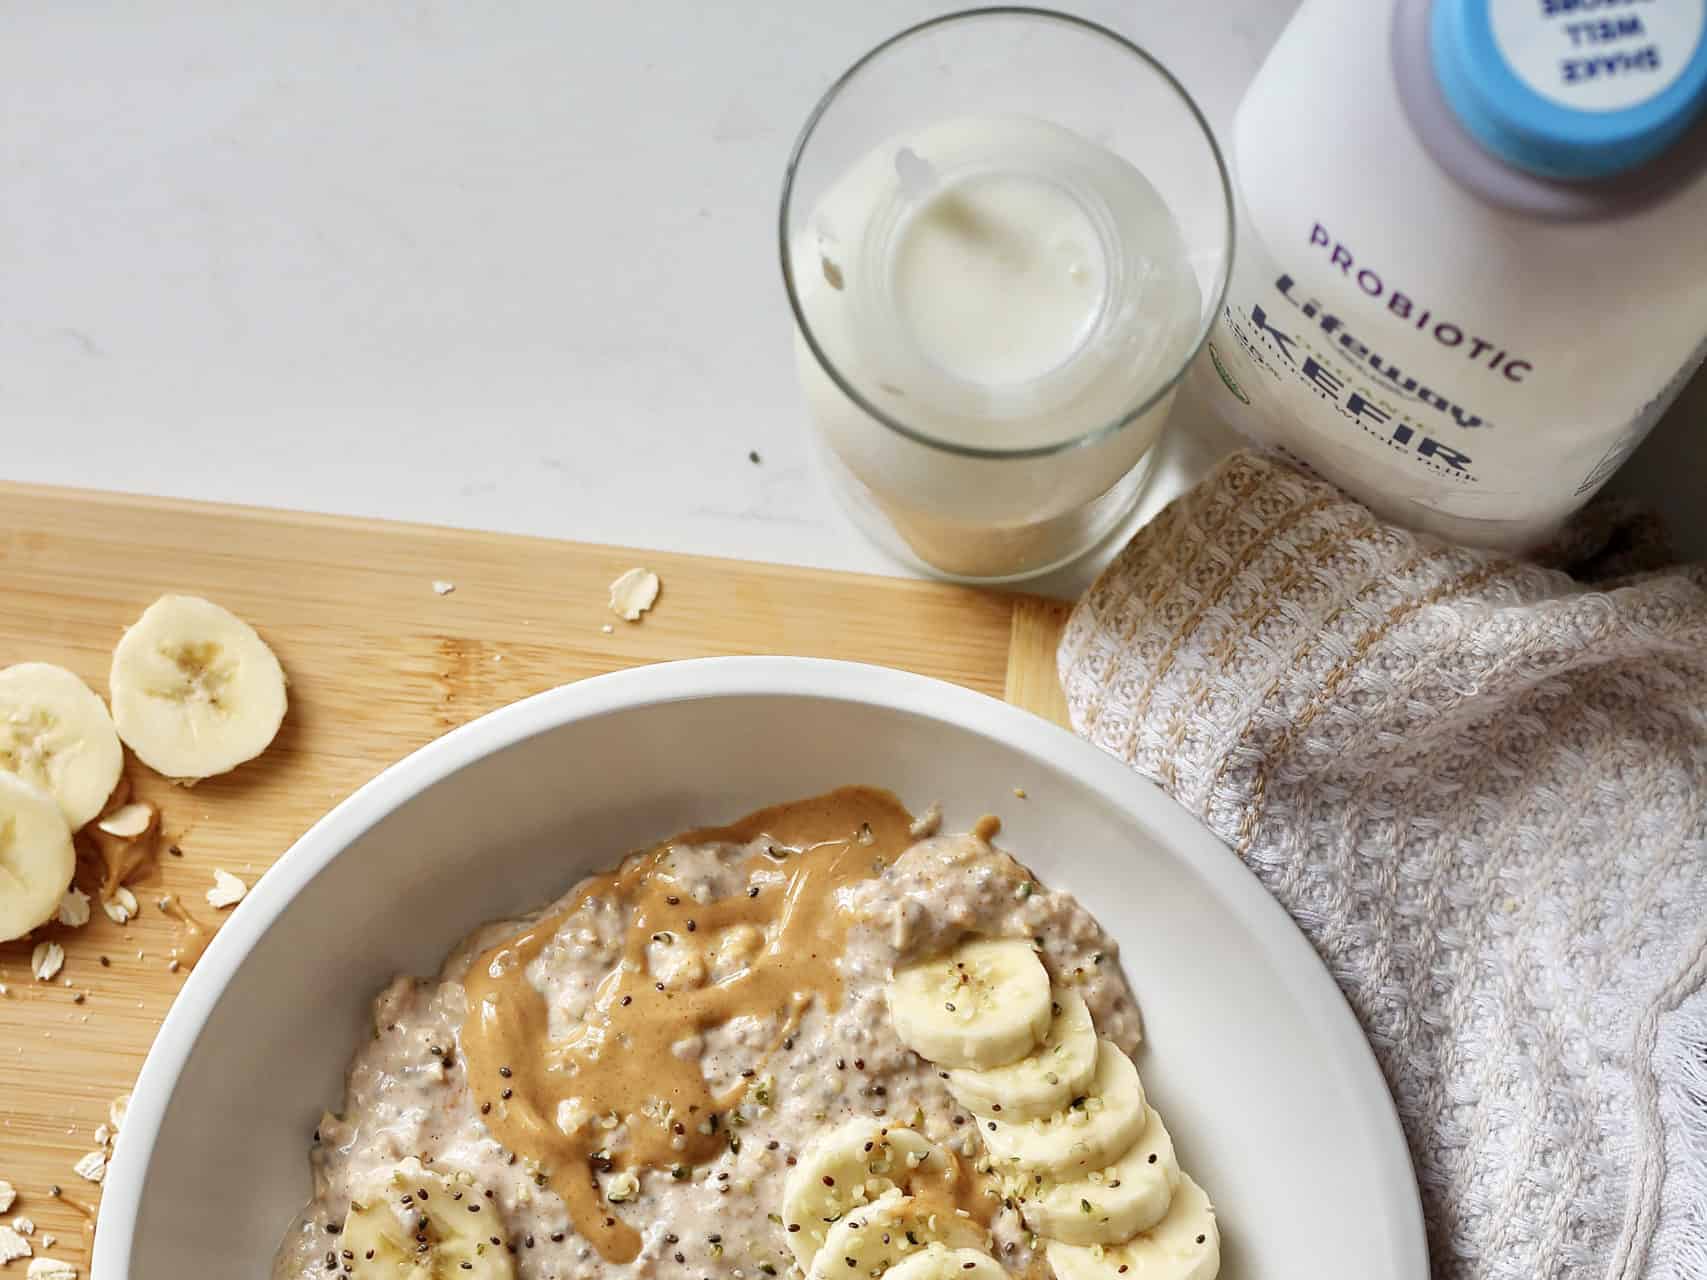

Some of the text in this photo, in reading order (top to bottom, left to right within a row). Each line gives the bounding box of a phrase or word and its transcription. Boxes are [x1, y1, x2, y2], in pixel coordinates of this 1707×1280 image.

[1562, 45, 1660, 86] SHAKE
[1566, 14, 1644, 47] WELL
[1274, 273, 1484, 429] Lifeway
[1310, 222, 1533, 383] PROBIOTIC
[1251, 303, 1473, 472] KEFIR
